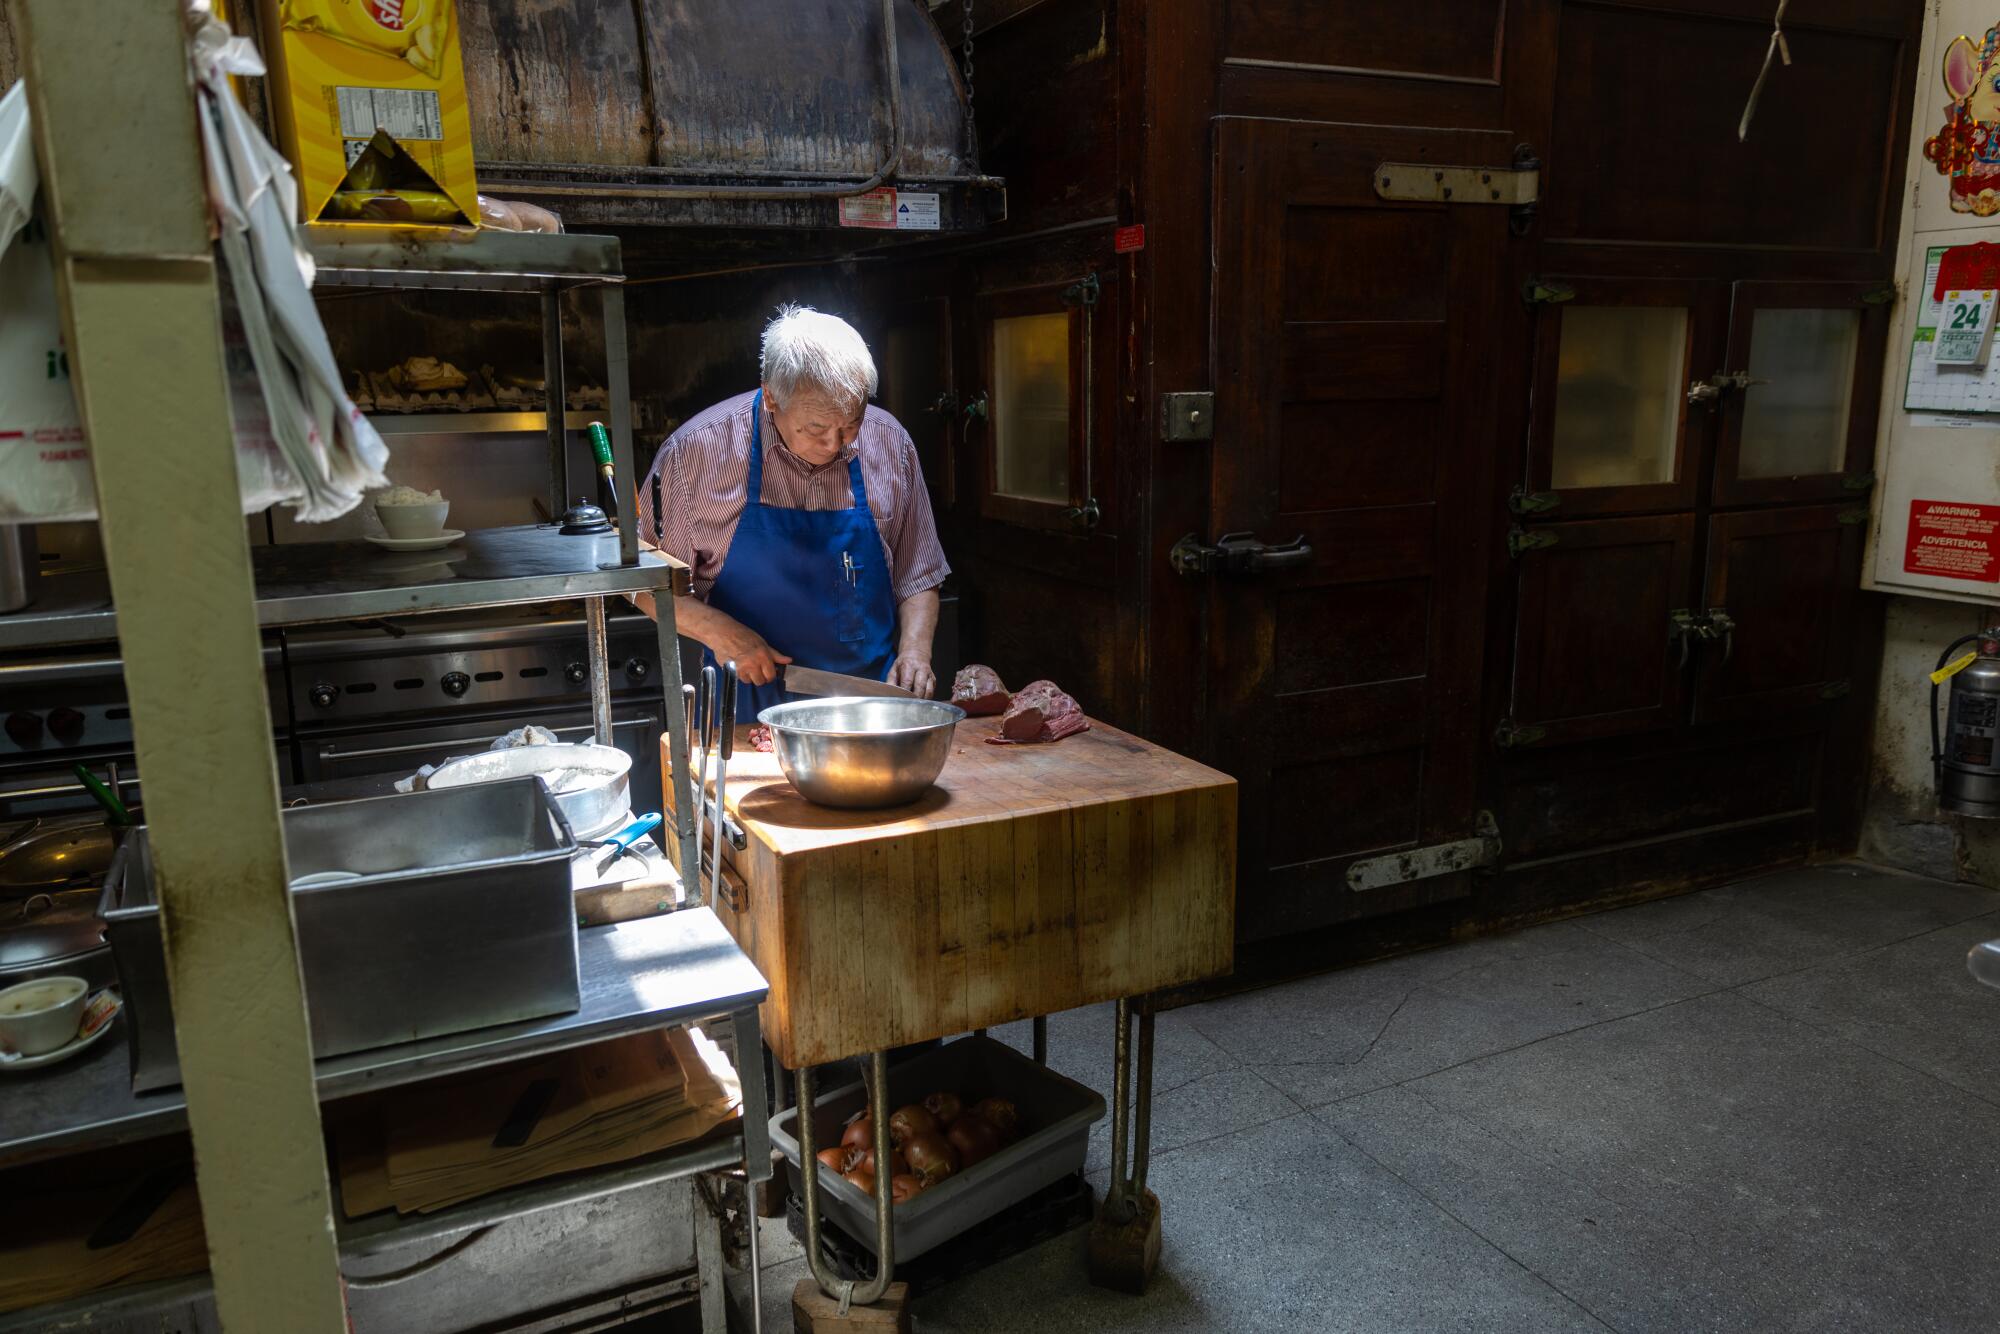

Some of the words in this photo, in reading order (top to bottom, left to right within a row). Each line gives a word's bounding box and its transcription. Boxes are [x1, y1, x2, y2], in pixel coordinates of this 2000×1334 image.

[1951, 303, 1982, 329] 24
[1935, 506, 1981, 518] WARNING
[1920, 535, 1988, 550] ADVERTENCIA
